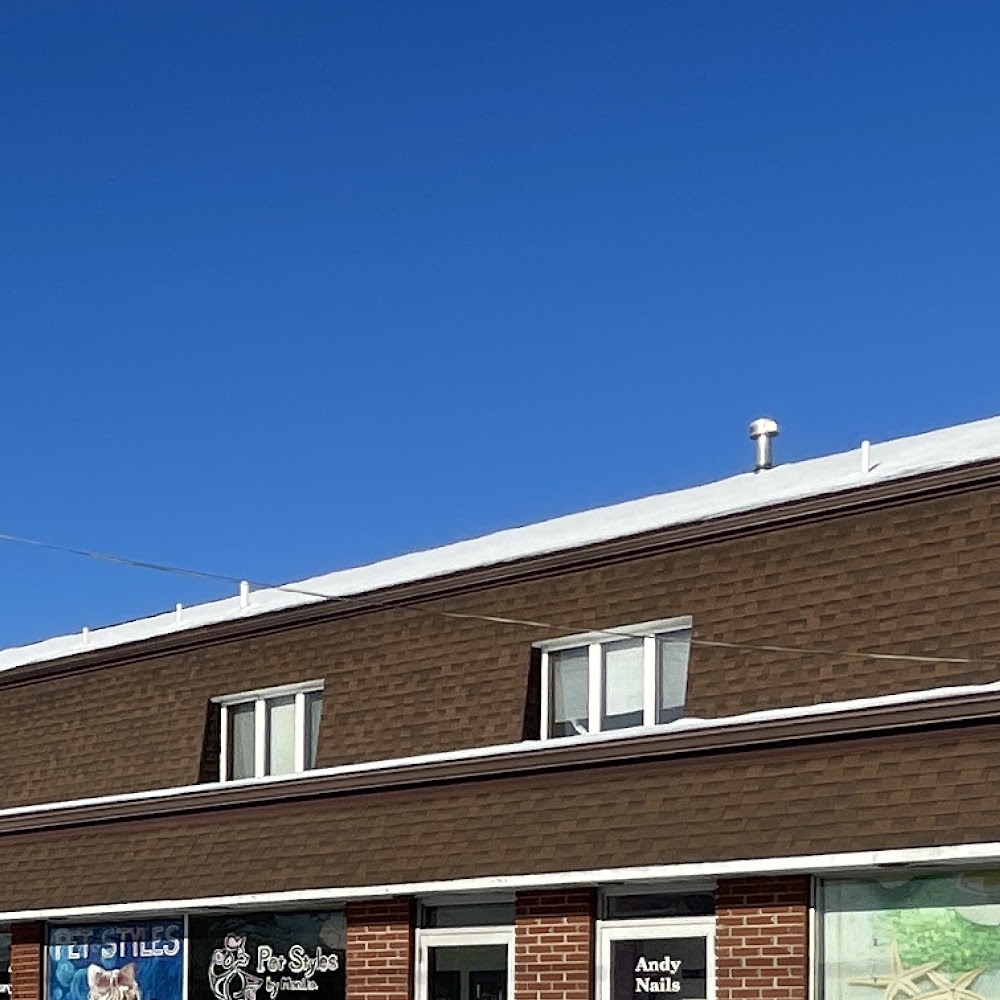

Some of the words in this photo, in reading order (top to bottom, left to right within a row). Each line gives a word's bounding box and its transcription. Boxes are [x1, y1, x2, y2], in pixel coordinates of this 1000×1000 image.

[54, 929, 92, 959] PET
[101, 925, 180, 958] STYLES
[256, 945, 287, 973] Pet
[288, 944, 339, 978] Styles
[635, 956, 682, 975] Andy
[266, 976, 280, 999] by
[635, 977, 681, 994] Nails
